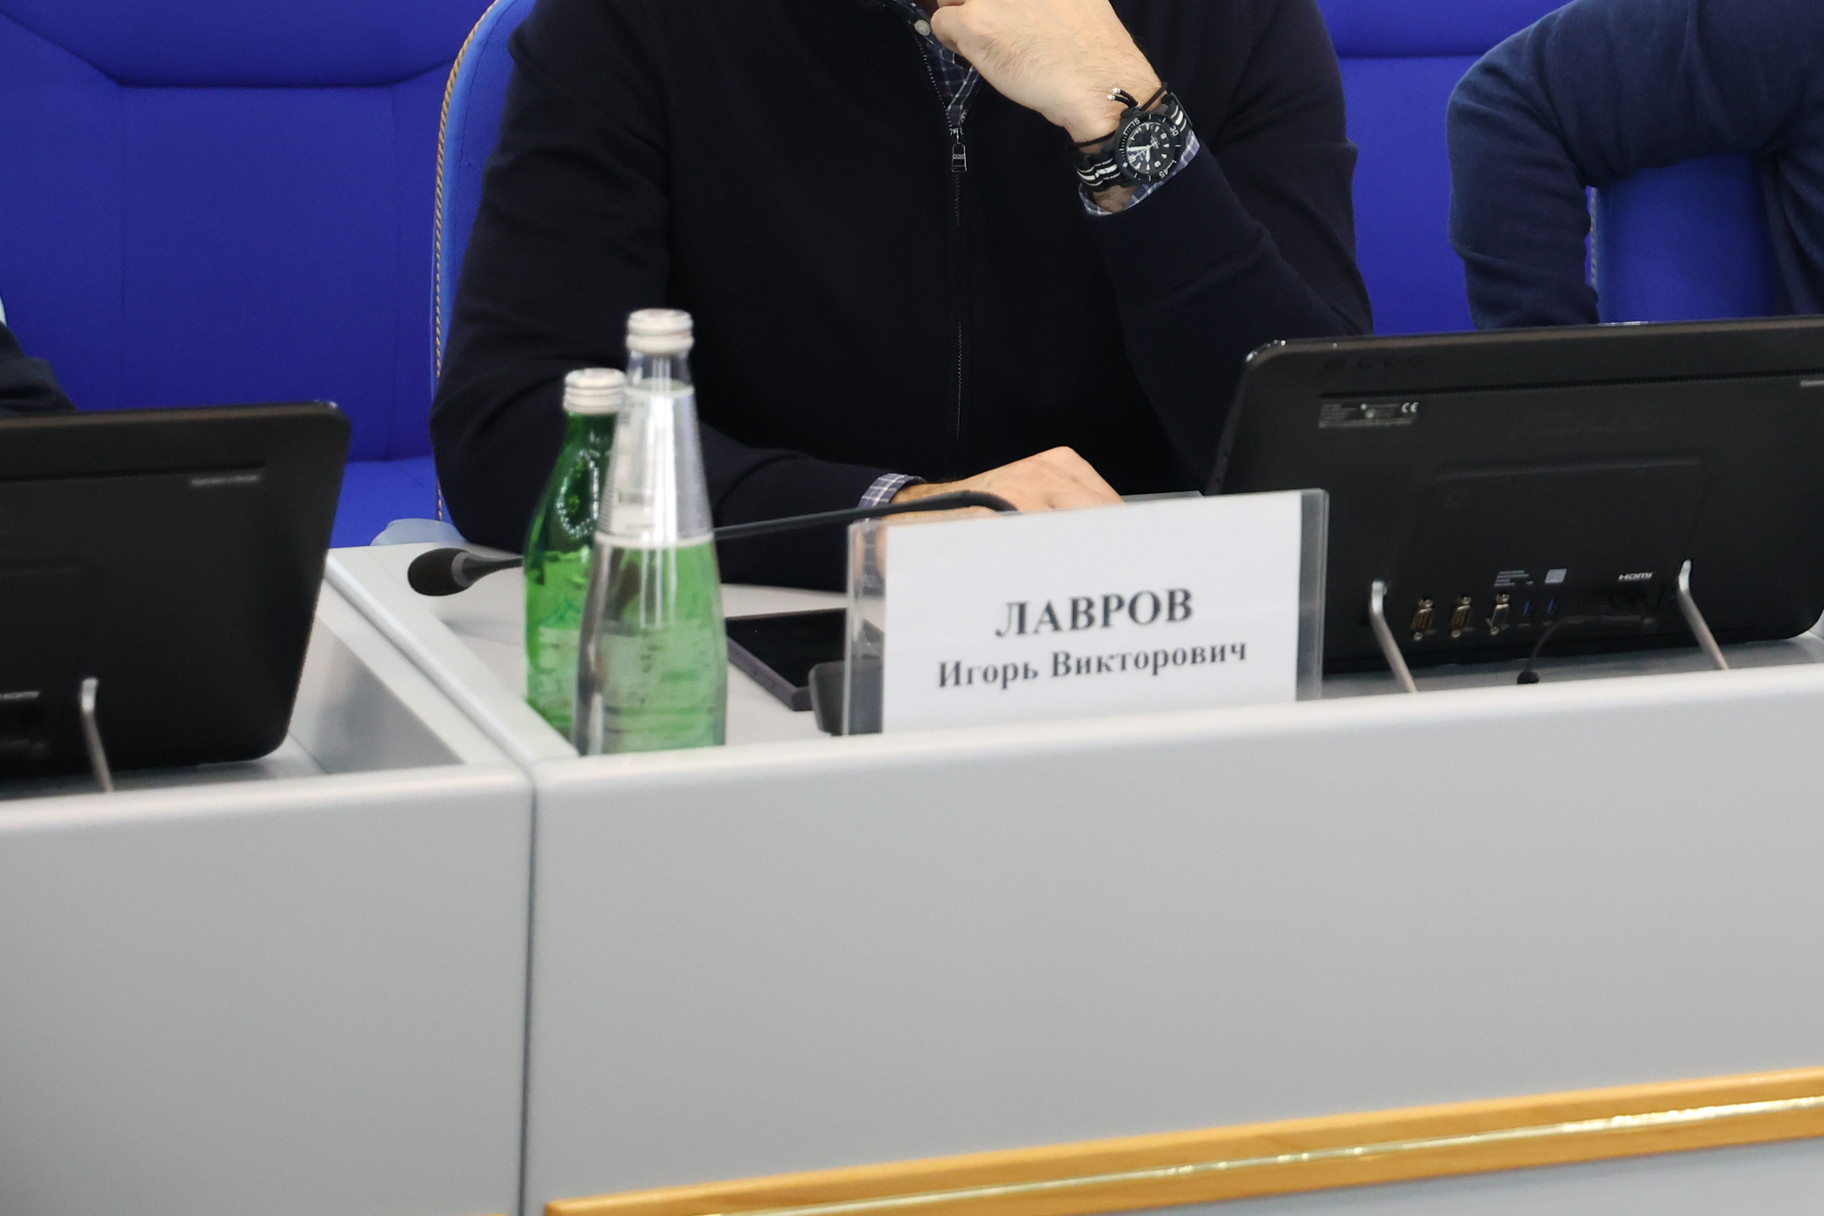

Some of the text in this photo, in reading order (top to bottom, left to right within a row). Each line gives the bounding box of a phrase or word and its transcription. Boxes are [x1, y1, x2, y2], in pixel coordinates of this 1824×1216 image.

[995, 588, 1193, 638] ЛАВРОВ
[938, 643, 1248, 690] Игорь Викторович
